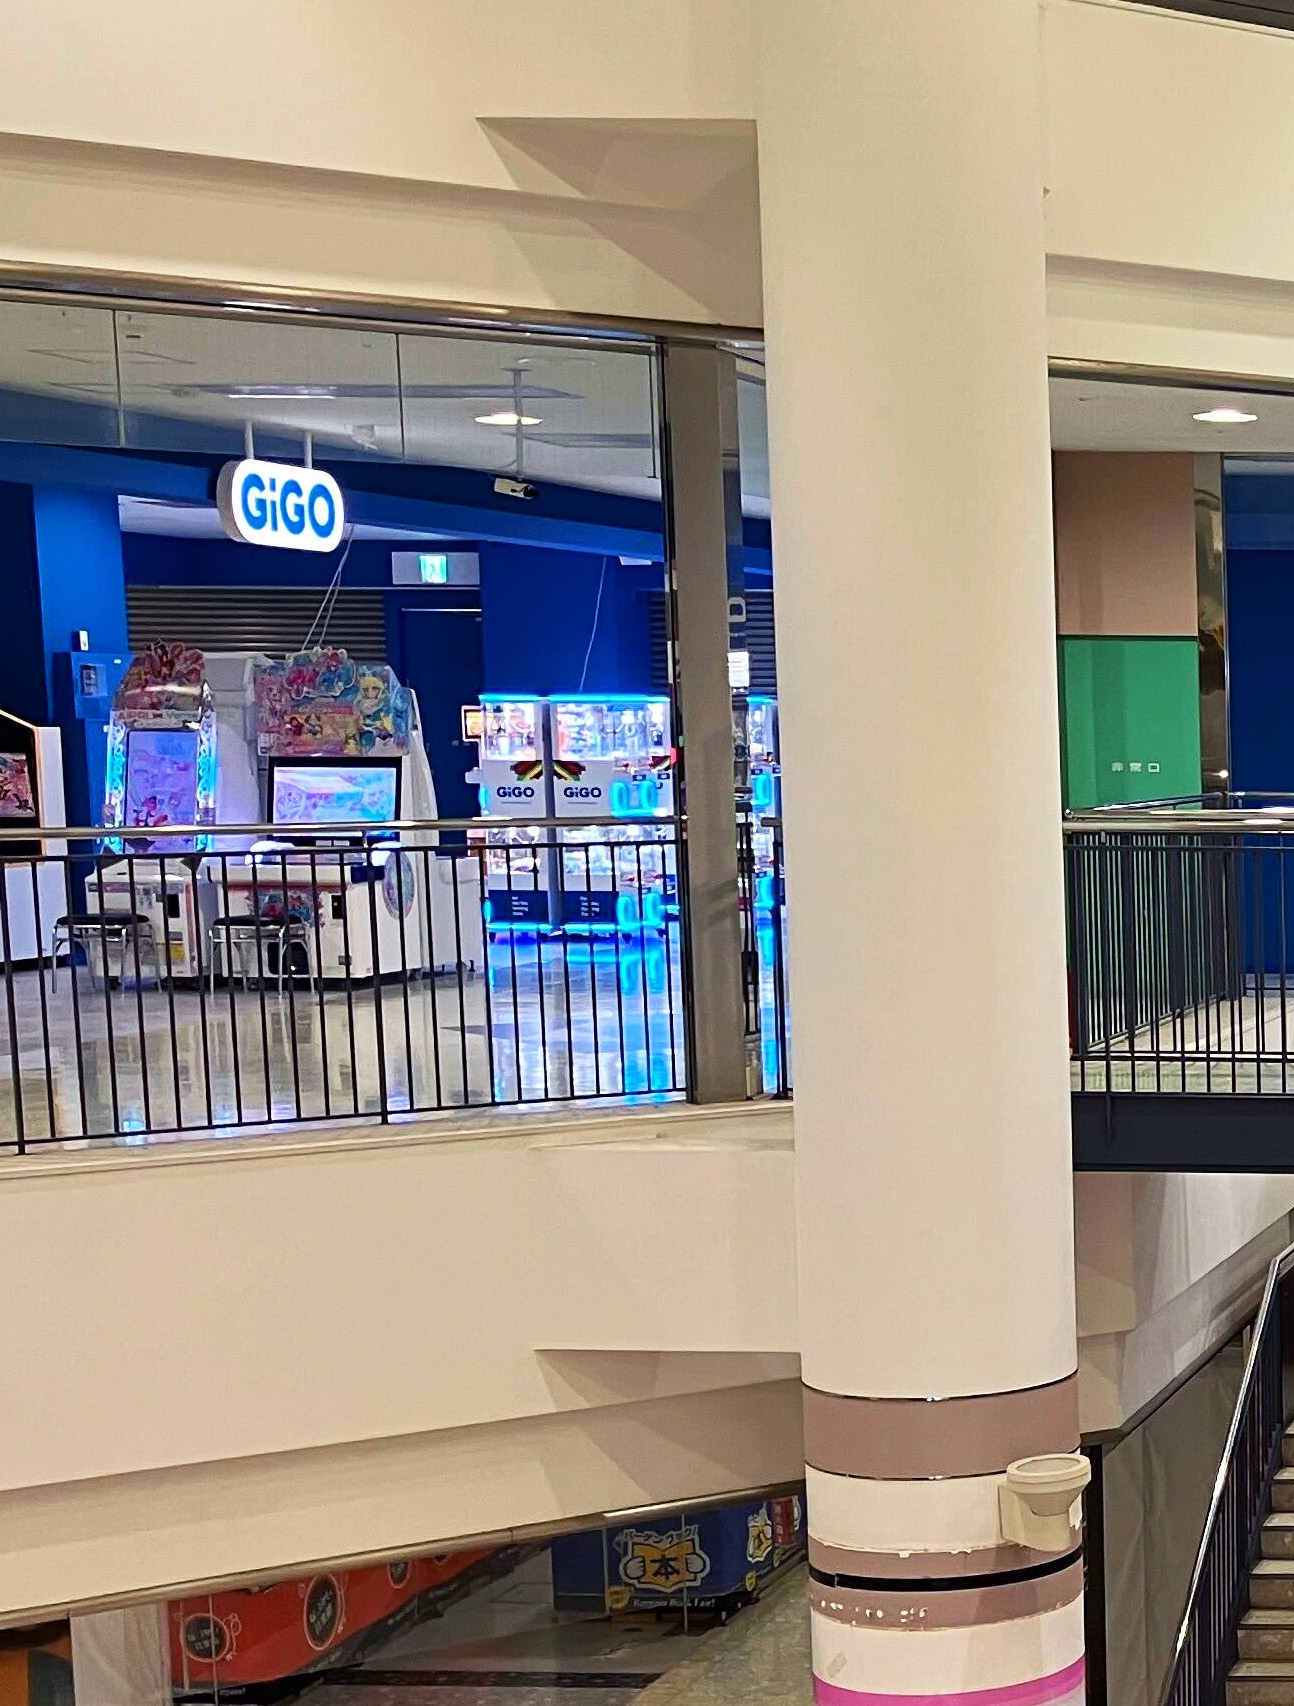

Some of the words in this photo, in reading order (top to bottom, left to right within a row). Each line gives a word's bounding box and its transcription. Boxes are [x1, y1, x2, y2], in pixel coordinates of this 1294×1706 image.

[241, 473, 336, 539] GiGO
[496, 786, 535, 798] GiGO
[563, 786, 602, 798] GiGO
[649, 1553, 680, 1581] 本
